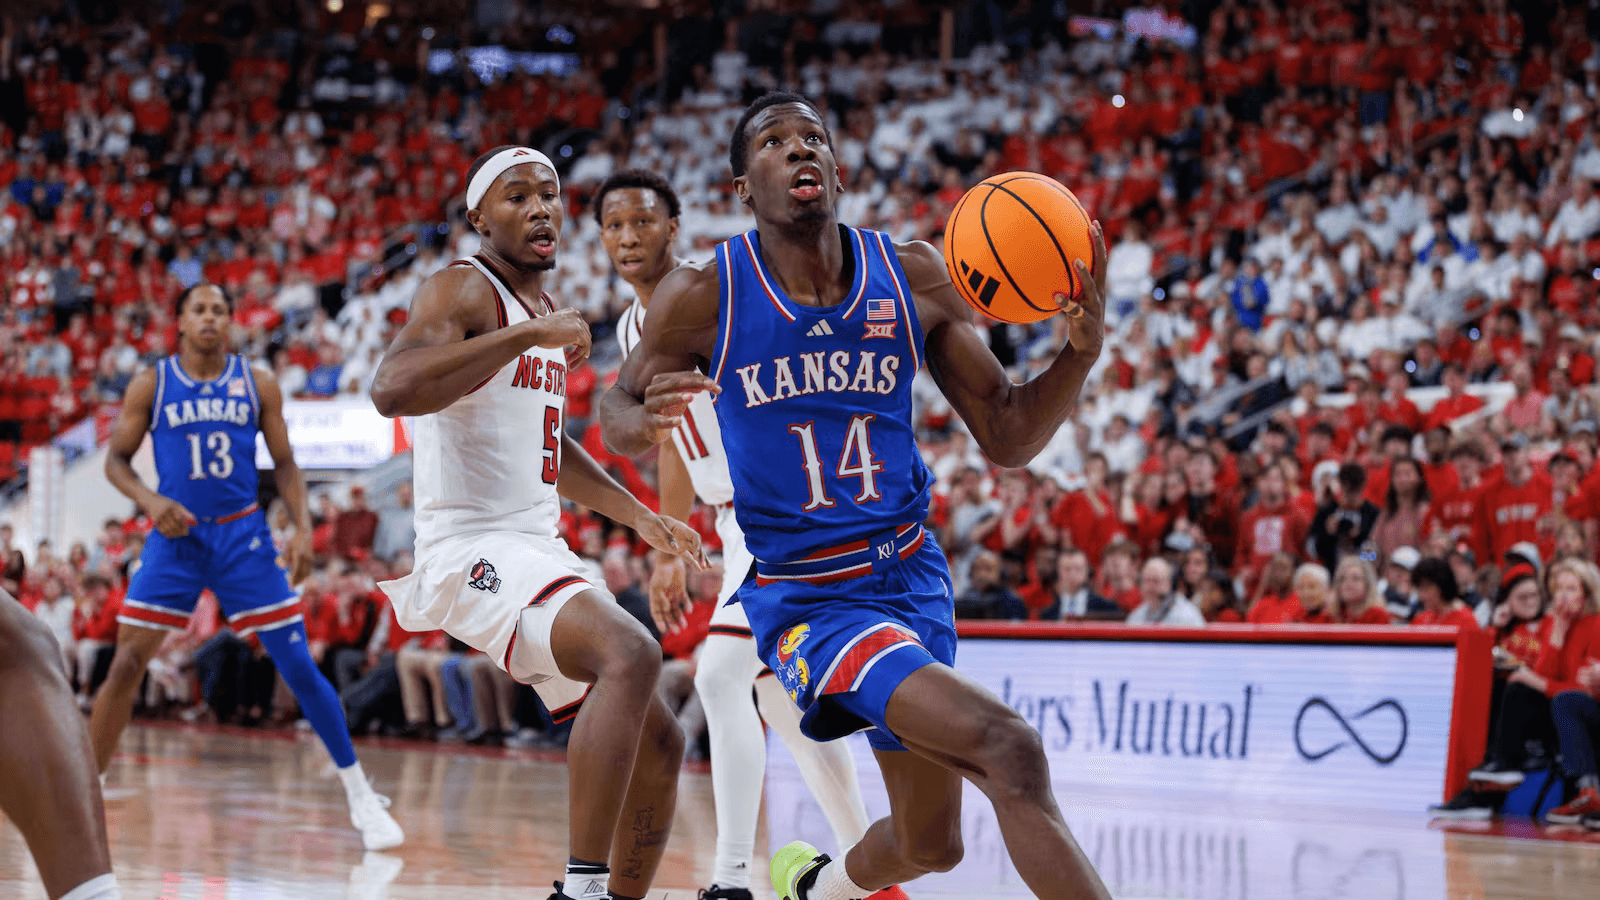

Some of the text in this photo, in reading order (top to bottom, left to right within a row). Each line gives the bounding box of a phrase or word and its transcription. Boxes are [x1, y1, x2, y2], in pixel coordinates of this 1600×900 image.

[863, 322, 897, 339] XII
[511, 355, 543, 390] NC
[735, 350, 900, 408] KANSAS
[164, 398, 250, 429] KANSAS
[186, 430, 235, 480] 13
[541, 405, 560, 485] 5
[788, 413, 885, 513] 14
[876, 540, 895, 560] KU
[1083, 680, 1254, 758] Mutual
